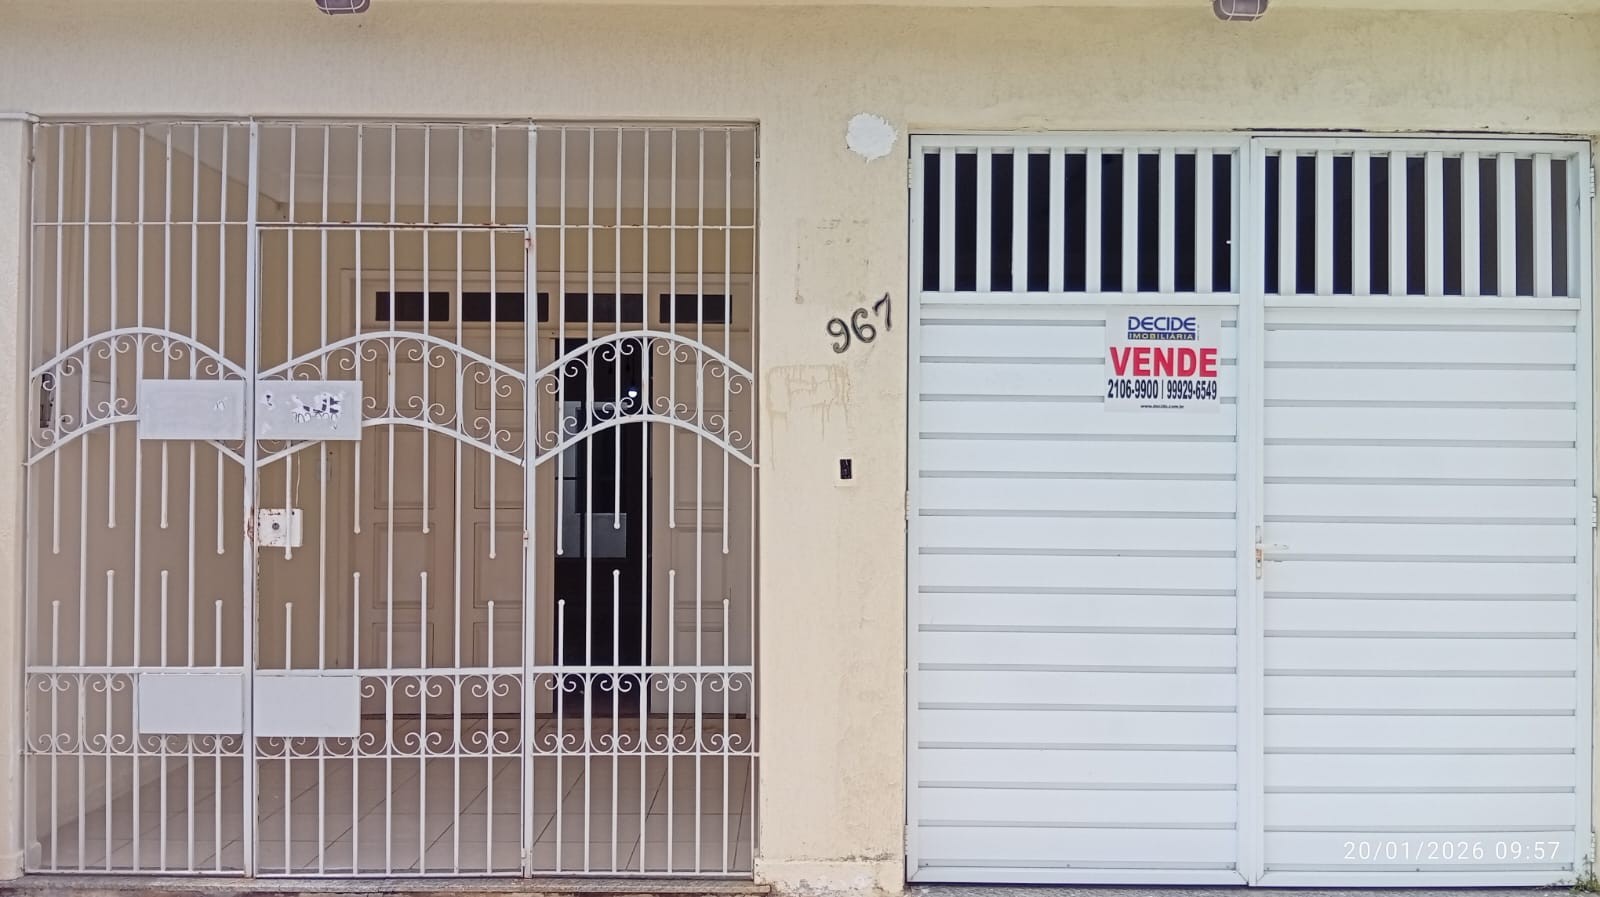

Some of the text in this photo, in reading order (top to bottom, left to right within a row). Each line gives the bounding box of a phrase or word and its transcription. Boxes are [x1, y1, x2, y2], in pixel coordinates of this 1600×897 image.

[826, 291, 892, 354] 967
[1127, 316, 1196, 331] DECIDE
[1109, 346, 1217, 377] VENDE
[1107, 378, 1158, 399] 2106-9900
[1166, 380, 1217, 400] 99929-6549
